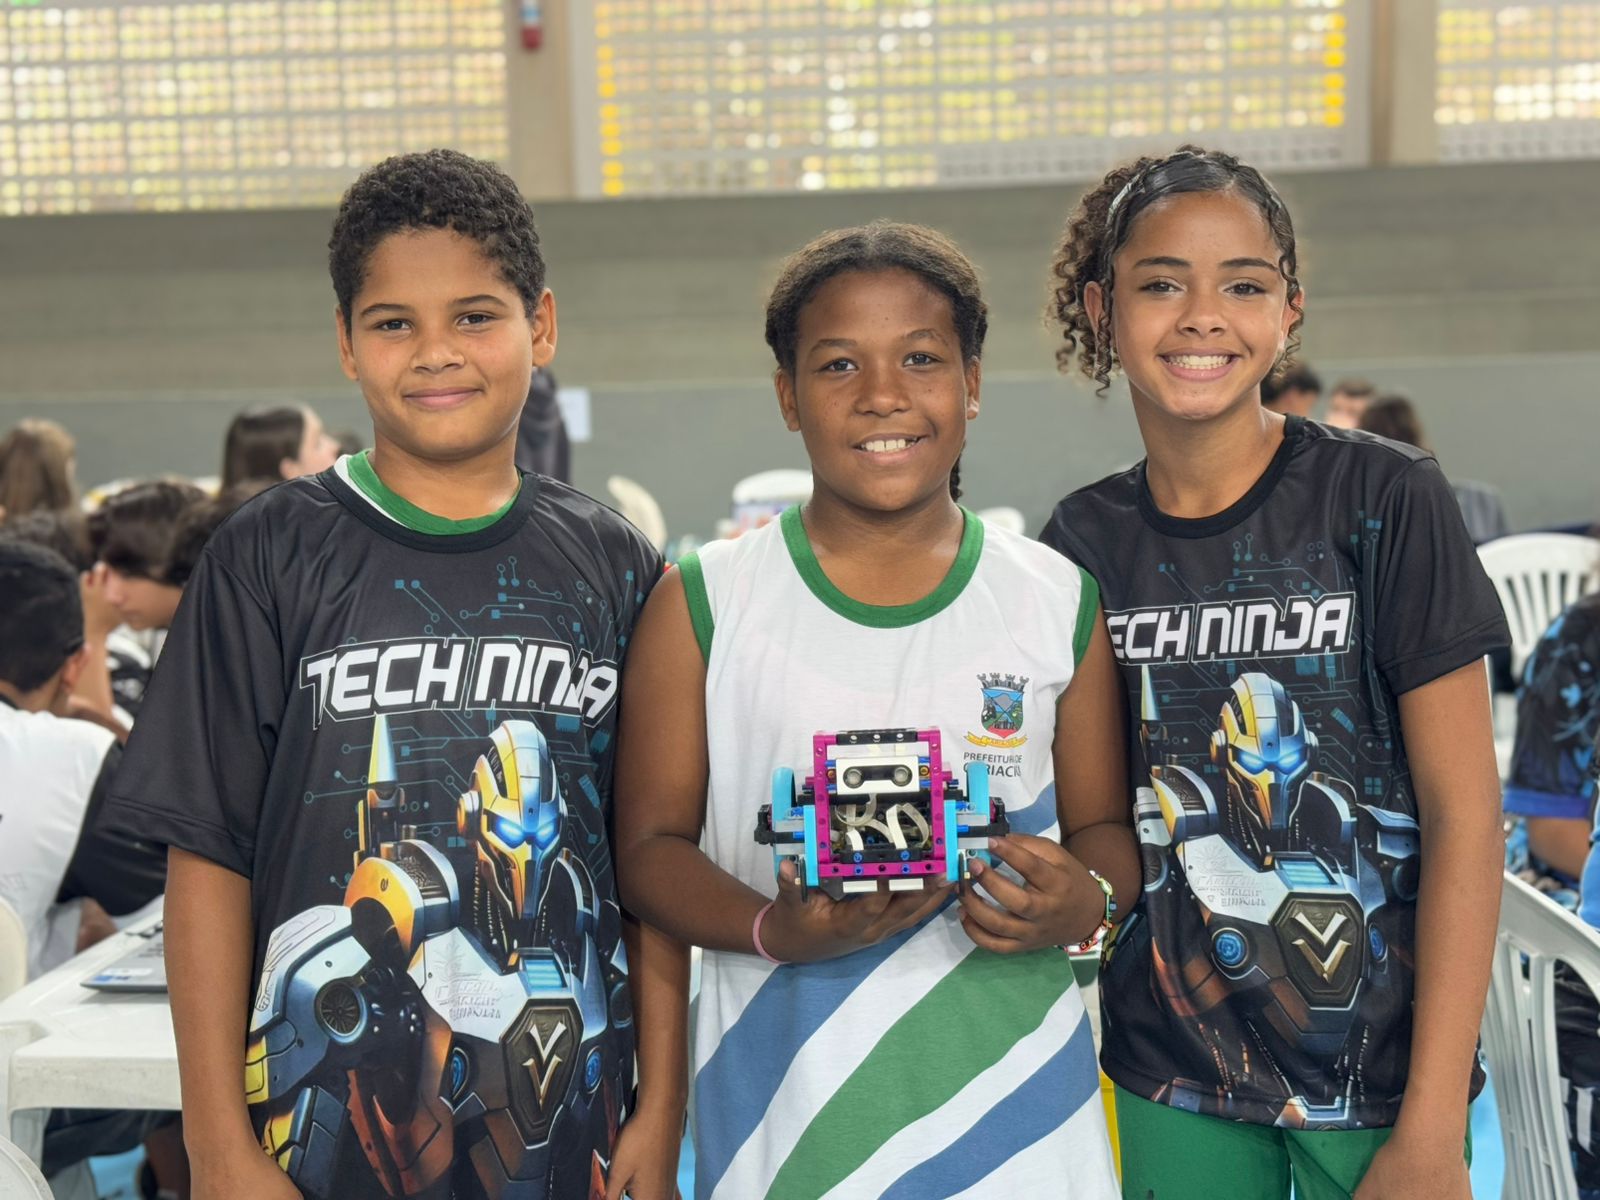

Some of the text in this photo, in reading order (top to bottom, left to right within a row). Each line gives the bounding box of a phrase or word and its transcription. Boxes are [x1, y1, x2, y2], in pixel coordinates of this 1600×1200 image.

[1106, 597, 1351, 660] ECH NINJA
[306, 643, 618, 726] TECH NINJA
